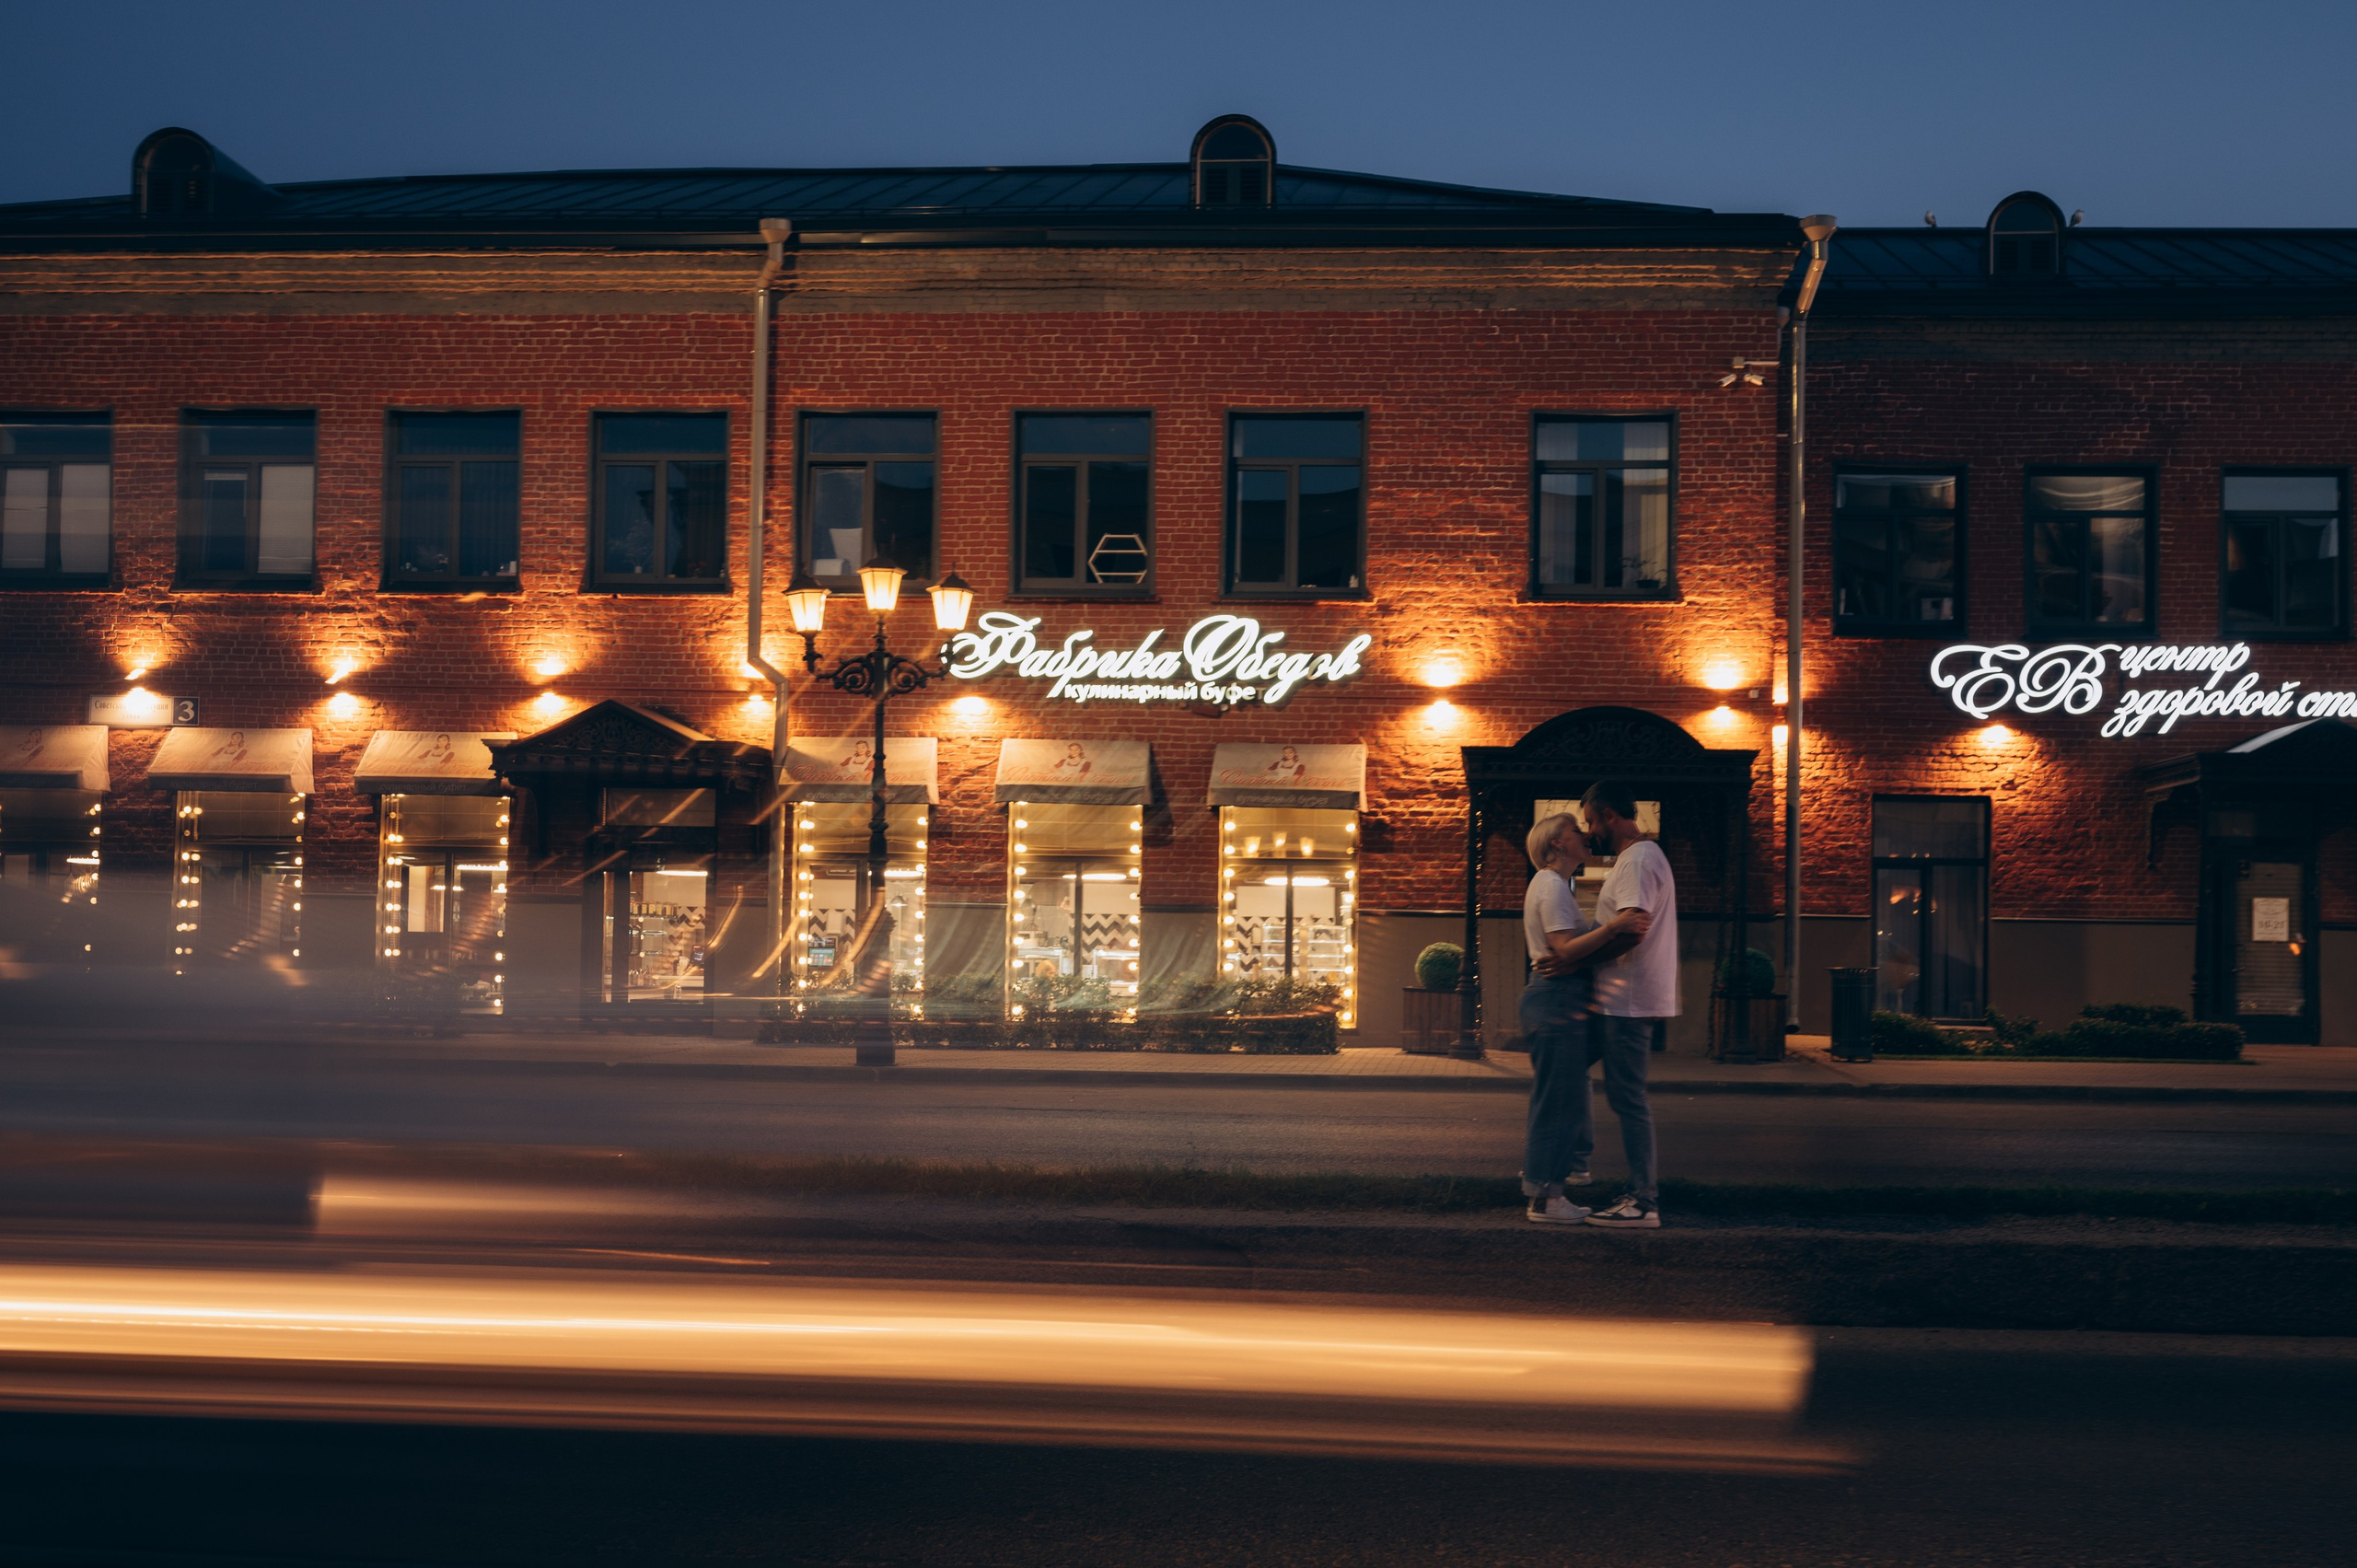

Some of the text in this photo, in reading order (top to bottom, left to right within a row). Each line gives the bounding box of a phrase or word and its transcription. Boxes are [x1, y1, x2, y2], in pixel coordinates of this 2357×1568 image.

[940, 611, 1372, 704] Фабрика Обедов
[2119, 642, 2251, 691] центр
[178, 700, 195, 722] 3
[1064, 681, 1267, 704] кулинарный буфет
[2101, 672, 2357, 738] здоровой ст
